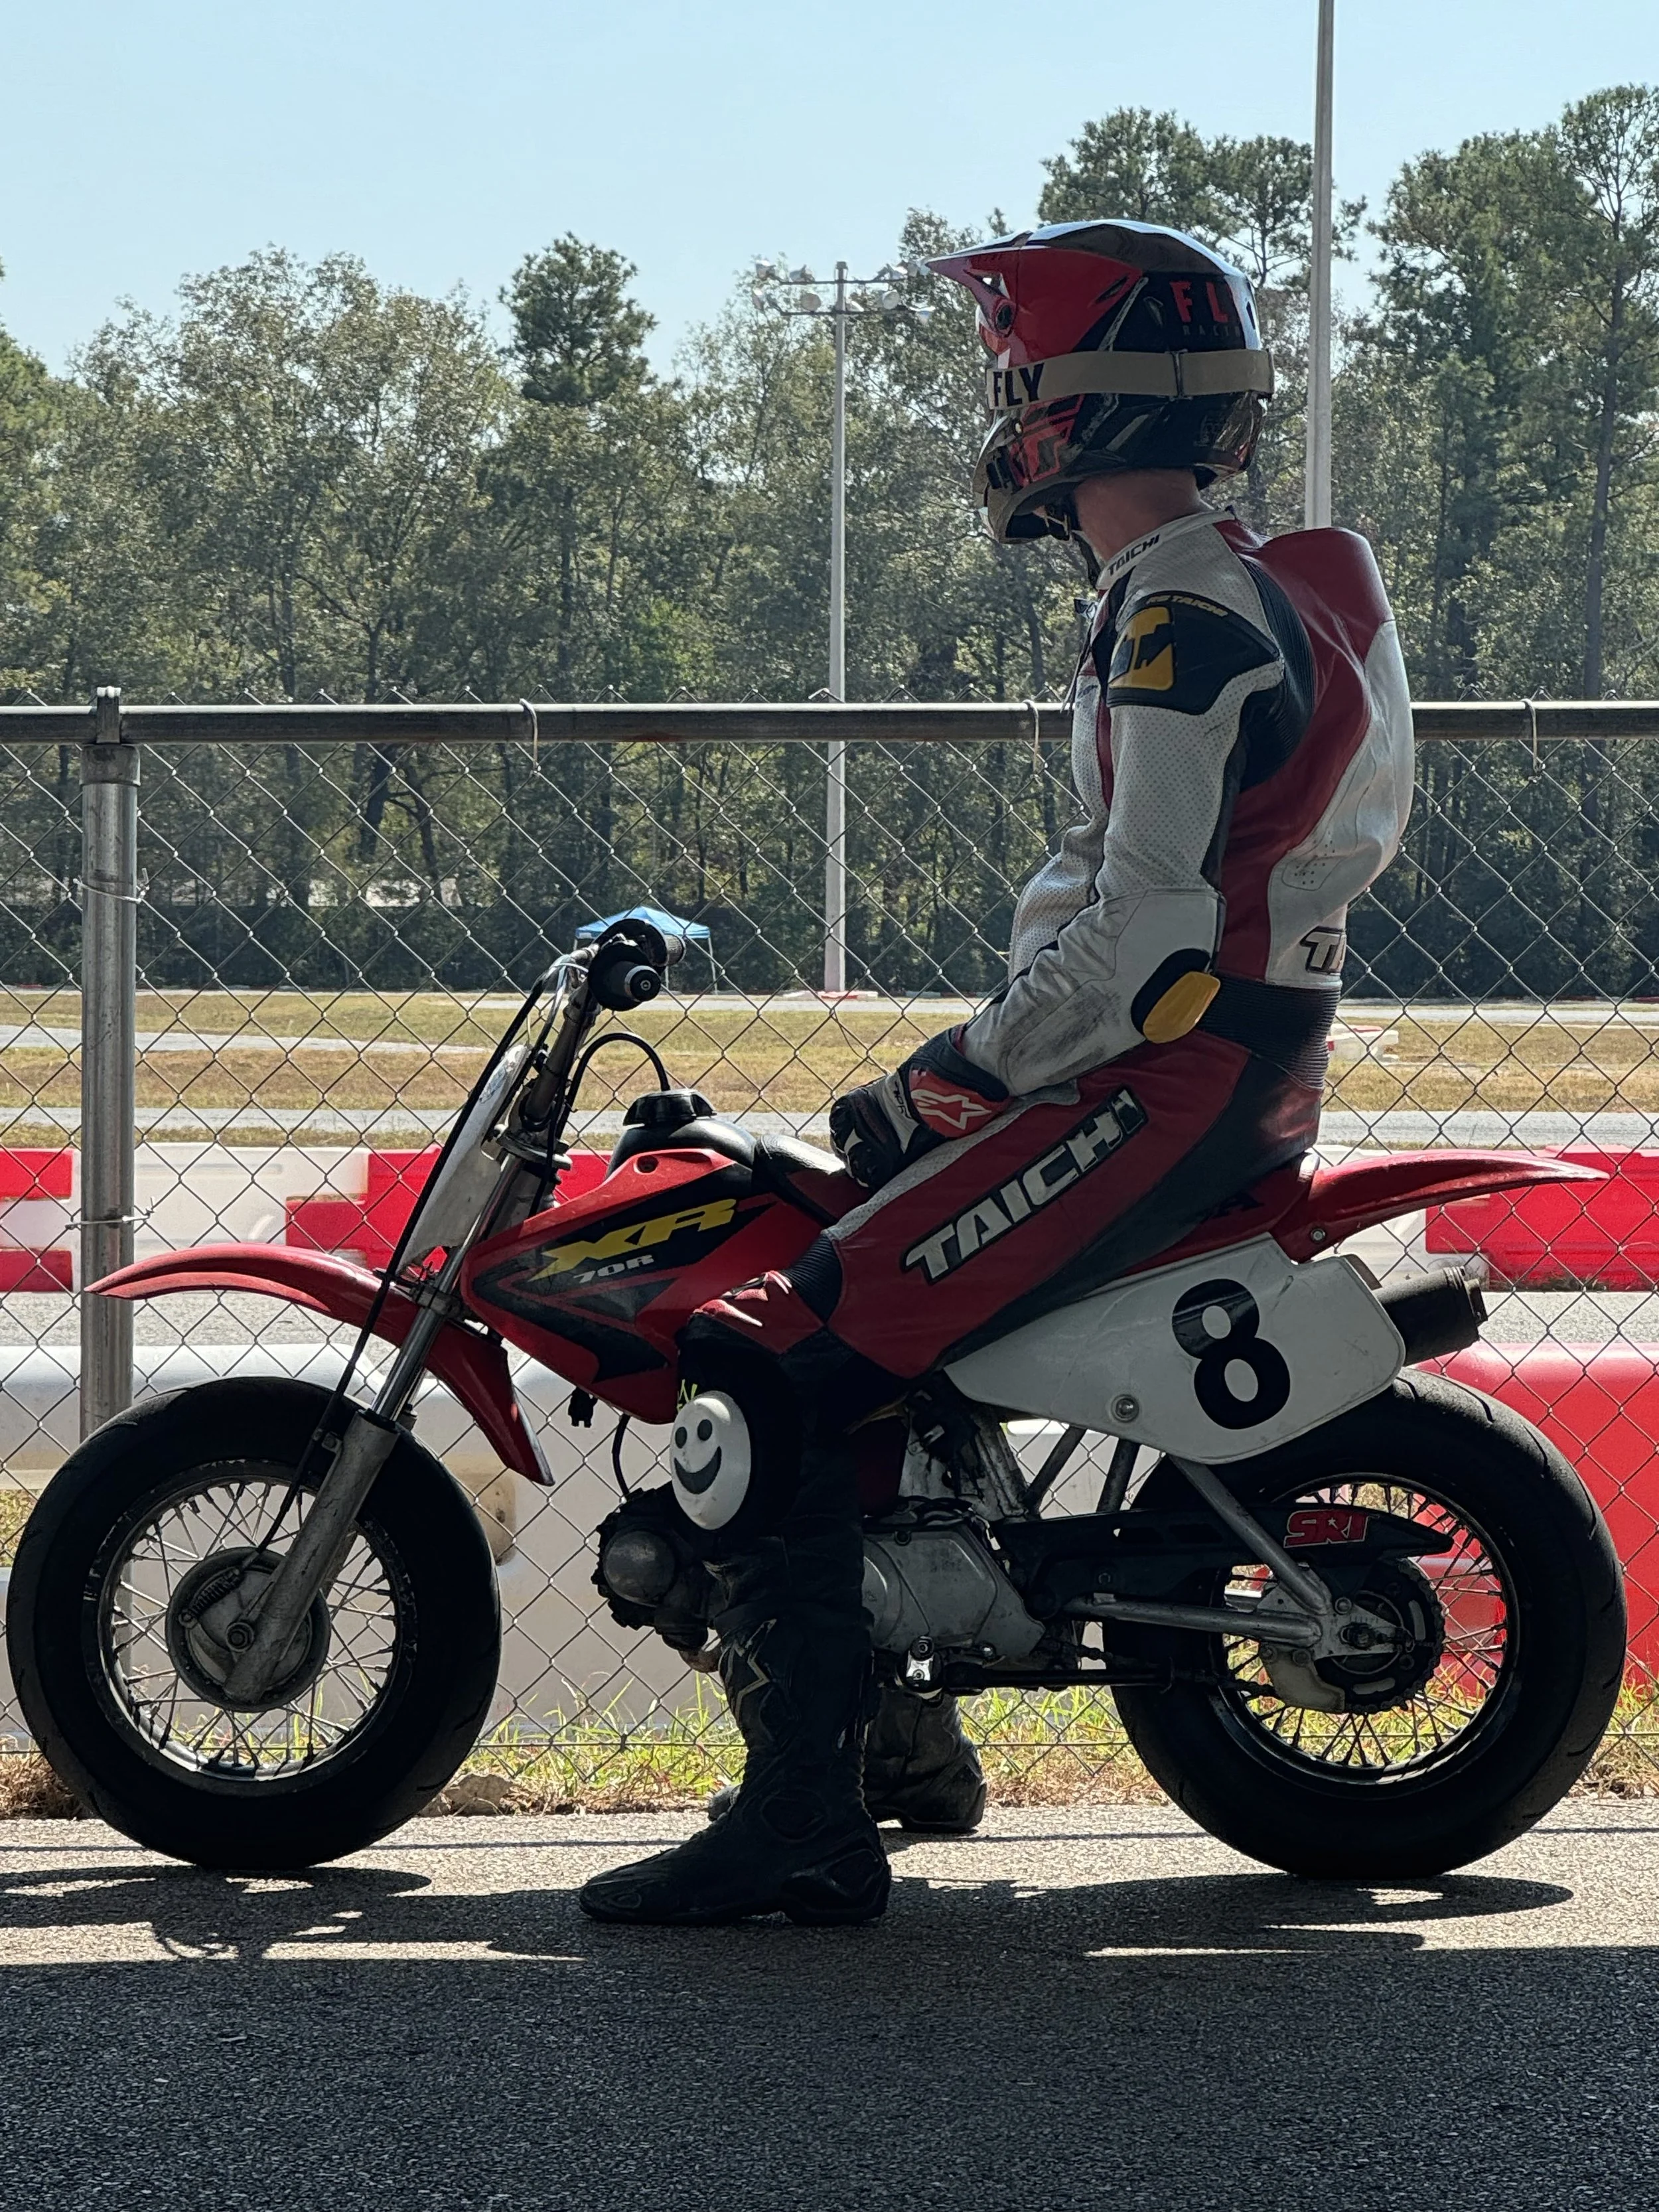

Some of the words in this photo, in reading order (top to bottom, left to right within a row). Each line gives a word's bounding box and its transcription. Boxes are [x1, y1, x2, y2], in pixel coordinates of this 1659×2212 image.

[1169, 280, 1231, 323] FL
[993, 362, 1045, 406] FLY
[1108, 534, 1160, 575] TAICHI
[901, 1088, 1148, 1283] TAICHI
[527, 1198, 737, 1282] XR
[573, 1254, 655, 1284] 70R
[1172, 1278, 1291, 1430] 8
